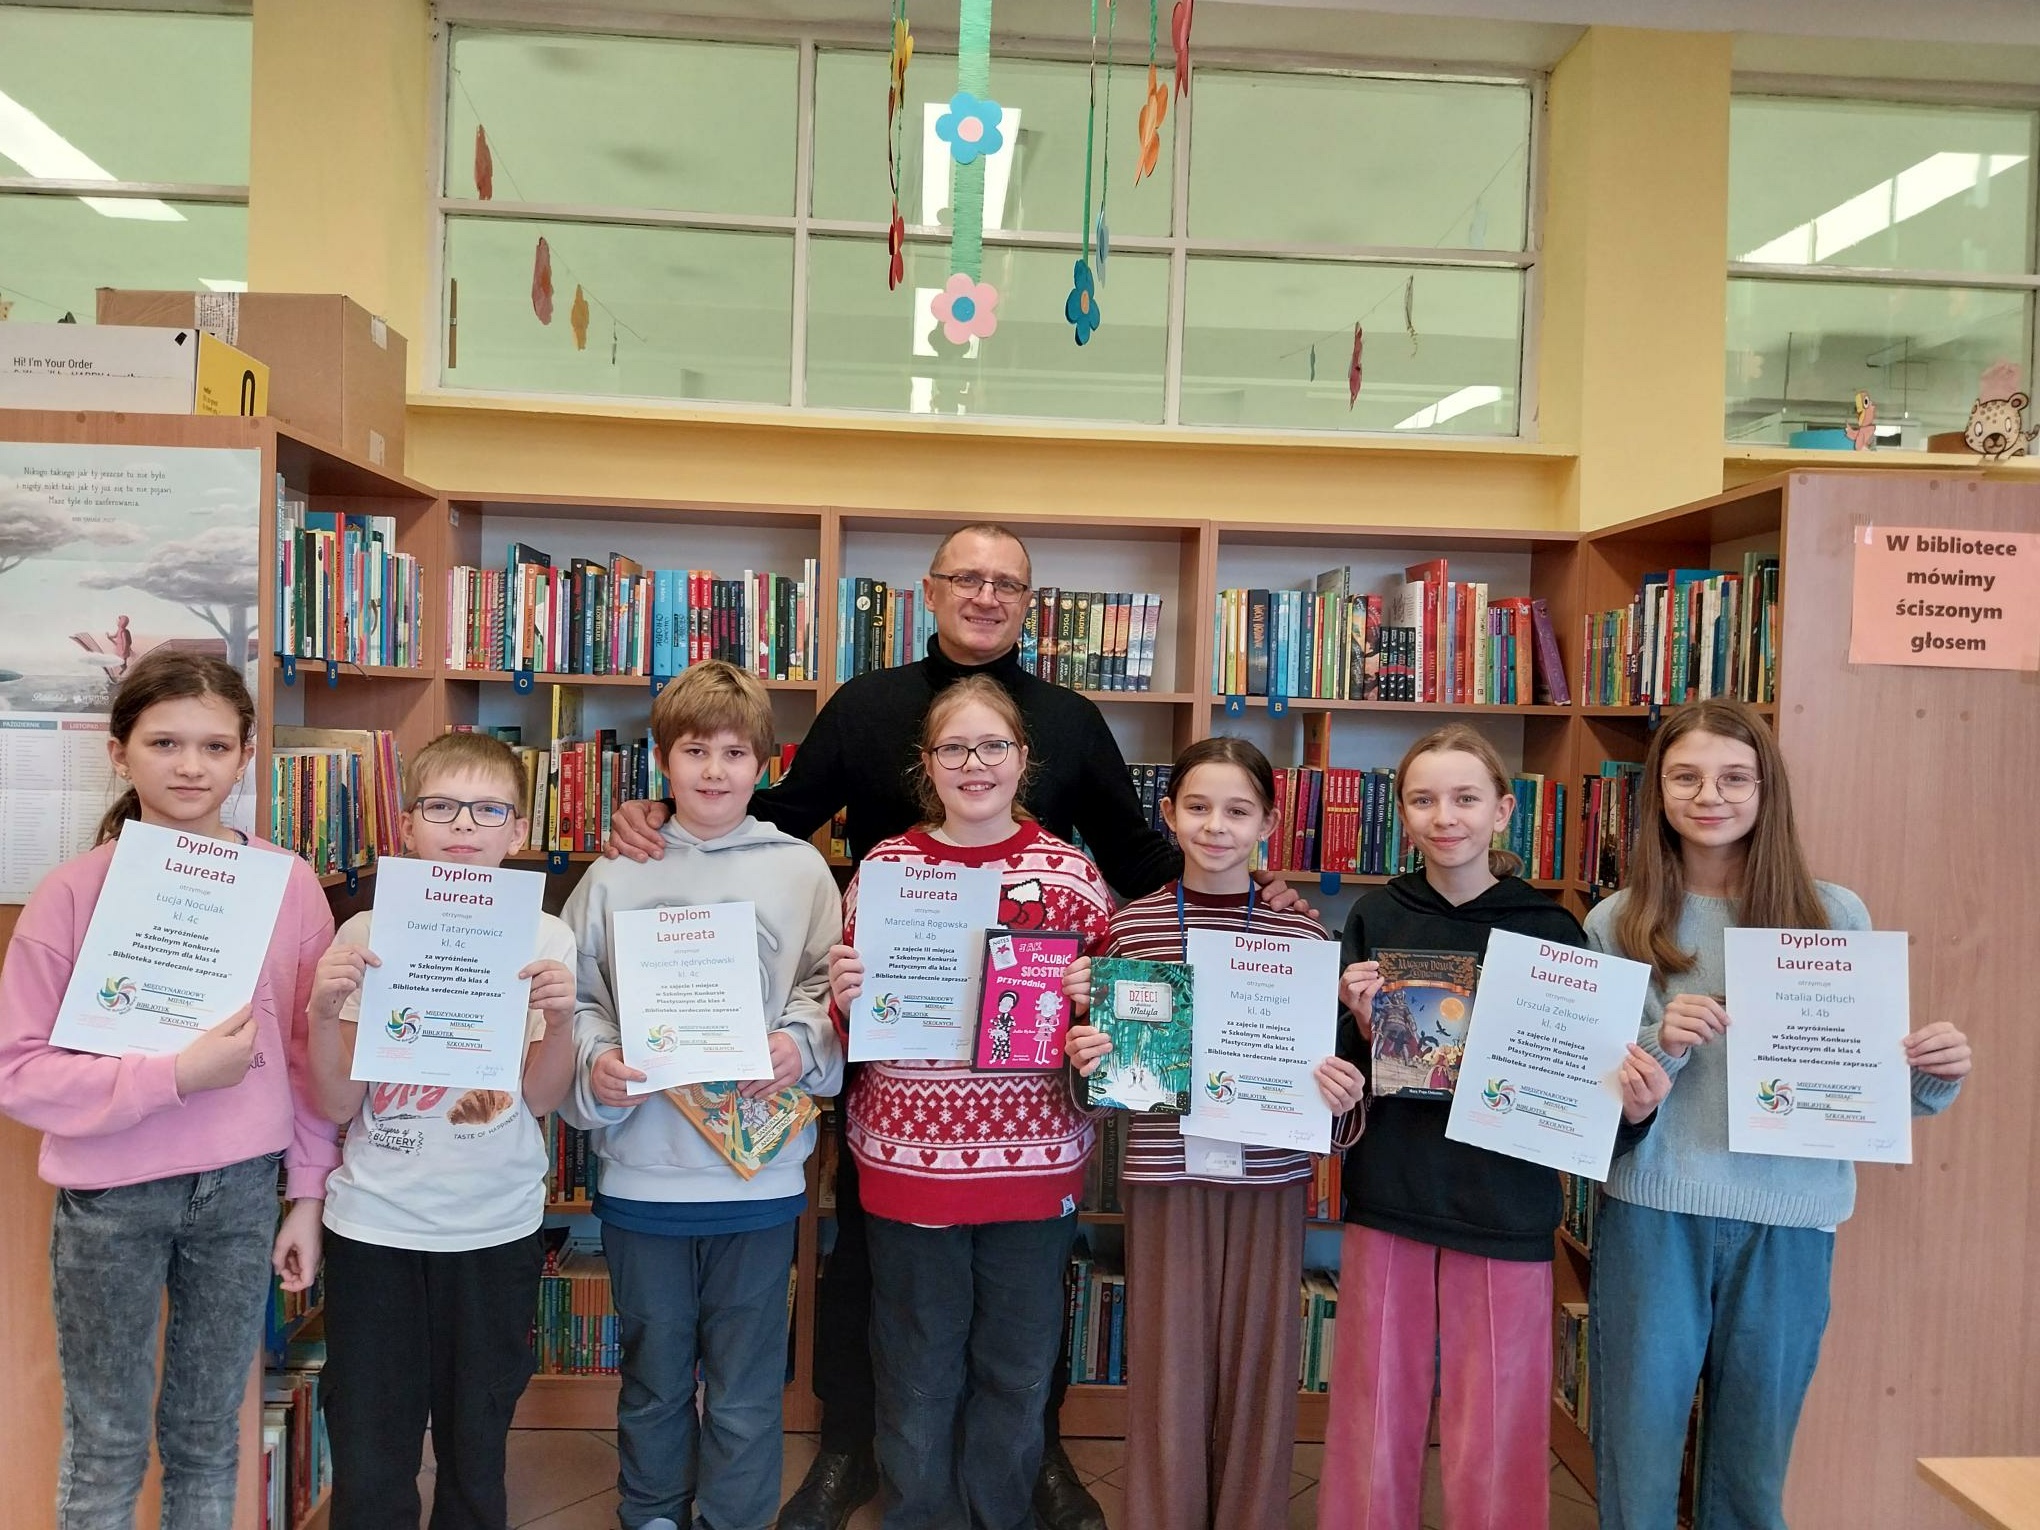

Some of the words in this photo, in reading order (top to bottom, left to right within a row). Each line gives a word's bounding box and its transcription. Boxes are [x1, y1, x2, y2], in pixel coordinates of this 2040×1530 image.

[13, 357, 26, 367] Hi!
[28, 358, 42, 368] I'm
[45, 358, 66, 368] Your
[68, 359, 93, 370] Order
[1886, 535, 1910, 552] W
[1916, 535, 2017, 556] bibliotece
[1906, 568, 1996, 592] mówimy
[1896, 599, 2003, 623] ściszonym
[1911, 632, 1986, 653] głosem
[287, 666, 293, 676] A
[331, 669, 336, 679] B
[656, 683, 664, 691] P
[1231, 701, 1239, 711] A
[1275, 702, 1282, 711] B
[176, 835, 238, 860] Dyplom
[554, 856, 561, 865] R
[164, 857, 235, 884] Laureata
[431, 865, 492, 883] Dyplom
[904, 866, 956, 880] Dyplom
[424, 887, 493, 906] Laureata
[899, 886, 958, 901] Laureata
[184, 898, 224, 914] Noculak
[658, 908, 710, 922] Dyplom
[407, 920, 438, 931] Dawid
[441, 923, 503, 937] Tatarynowicz
[884, 917, 925, 927] Marcelina
[926, 918, 968, 930] Rogowska
[143, 932, 181, 946] Szkolnym
[182, 940, 220, 953] Konkursie
[656, 929, 715, 942] Laureata
[1780, 932, 1847, 949] Dyplom
[1235, 935, 1290, 952] Dyplom
[131, 940, 180, 956] Plastycznym
[180, 951, 193, 959] dla
[194, 953, 210, 962] klas
[1539, 943, 1598, 969] Dyplom
[153, 959, 194, 972] serdecznie
[417, 962, 453, 972] Szkolnym
[454, 965, 490, 974] Konkursie
[1230, 957, 1292, 975] Laureata
[1777, 956, 1852, 971] Laureata
[408, 971, 454, 982] Plastycznym
[467, 976, 482, 984] klas
[996, 976, 1046, 990] przyrodnią
[1530, 965, 1597, 993] Laureata
[430, 986, 469, 995] serdecznie
[1129, 990, 1158, 1003] DZIECI
[1230, 990, 1252, 1001] Maja
[1129, 1006, 1159, 1017] Motyla
[1265, 1024, 1290, 1032] miejsca
[1228, 1029, 1260, 1038] Szkolnym
[1261, 1032, 1295, 1042] Konkursie
[1220, 1037, 1262, 1048] Plastycznym
[1274, 1043, 1288, 1051] klas
[1516, 1038, 1551, 1052] Szkolnym
[1552, 1047, 1588, 1061] Konkursie
[1558, 1040, 1585, 1050] miejsca
[1242, 1052, 1277, 1062] serdecznie
[1507, 1045, 1551, 1062] Plastycznym
[1552, 1057, 1564, 1065] dla
[1564, 1060, 1579, 1069] klas
[373, 1132, 416, 1147] BUTTERY
